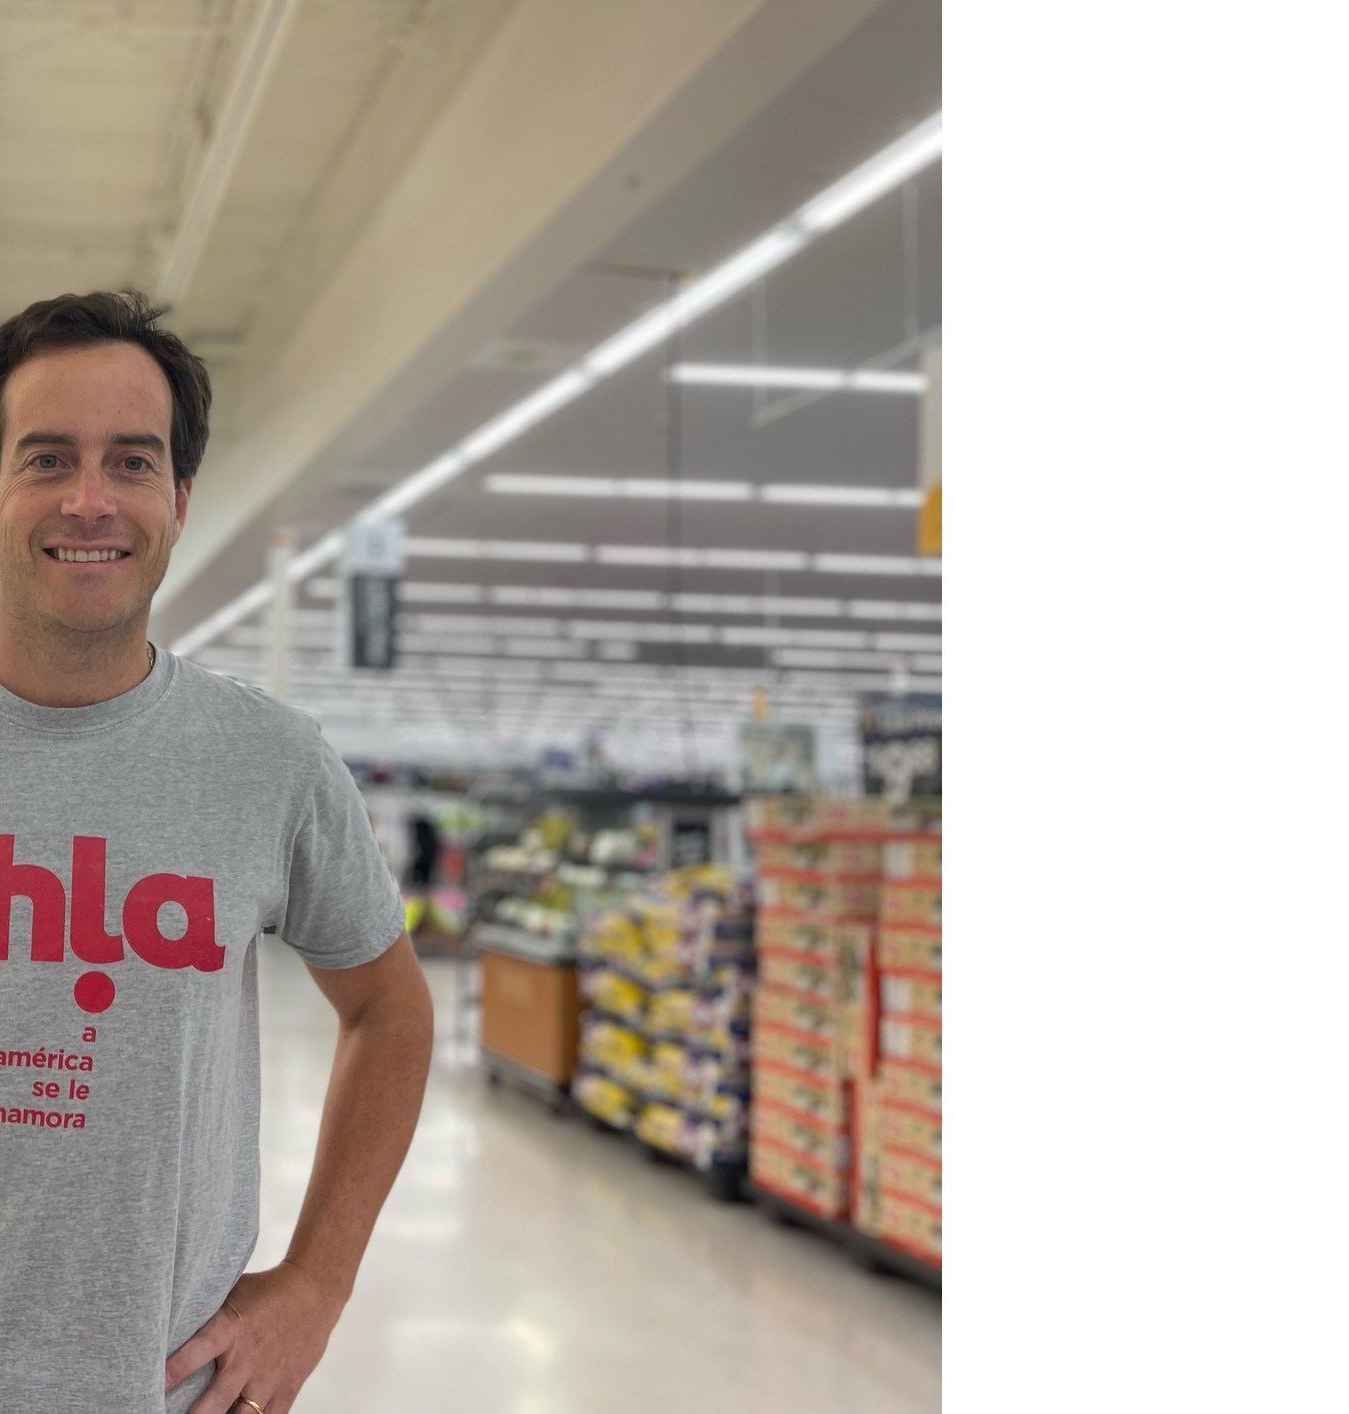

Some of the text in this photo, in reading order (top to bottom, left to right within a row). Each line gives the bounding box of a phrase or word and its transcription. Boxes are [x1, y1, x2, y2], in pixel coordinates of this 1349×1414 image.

[82, 1027, 97, 1043] a
[32, 1079, 90, 1100] se le
